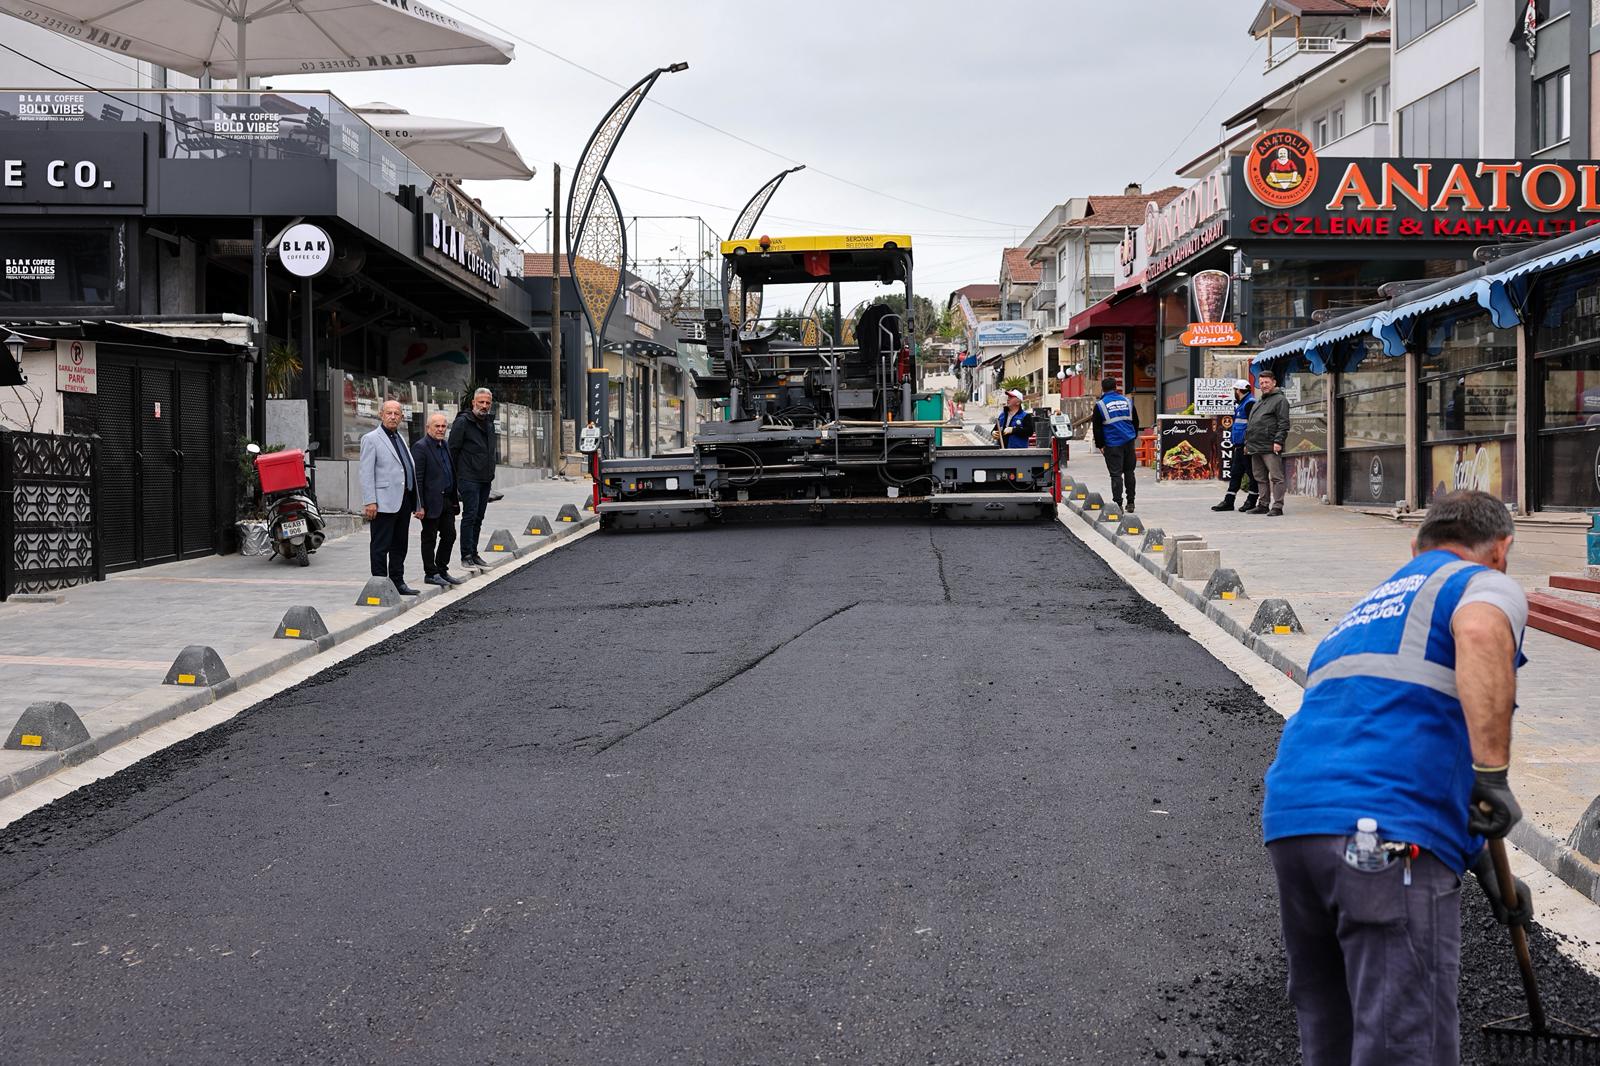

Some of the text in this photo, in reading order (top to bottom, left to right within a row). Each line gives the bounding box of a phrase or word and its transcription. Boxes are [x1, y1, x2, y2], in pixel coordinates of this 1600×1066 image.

[19, 94, 84, 103] BLAK COFFEE
[19, 103, 85, 115] BOLD VIBES
[214, 112, 280, 121] BLAK COFFEE
[214, 121, 280, 133] BOLD VIBES
[395, 129, 413, 138] CO.
[1258, 134, 1308, 154] ANATOLIA
[47, 159, 112, 188] CO.
[1155, 168, 1228, 253] ANATOLIA
[1249, 213, 1389, 236] GÖZLEME
[1398, 218, 1424, 235] &
[1433, 218, 1577, 236] KAHVALTI
[282, 240, 326, 252] BLAK
[432, 212, 466, 266] BLAK
[467, 250, 491, 282] COFFEE
[1173, 236, 1200, 263] KAHVALTI
[1201, 220, 1224, 248] SARAYI
[5, 258, 56, 266] BLAK COFFEE
[5, 265, 56, 274] BOLD VIBES
[1192, 324, 1234, 335] ANATOLIA
[1190, 334, 1236, 345] döner
[58, 364, 73, 372] GARAJ
[68, 373, 85, 384] PARK
[1220, 430, 1234, 479] DÖNER
